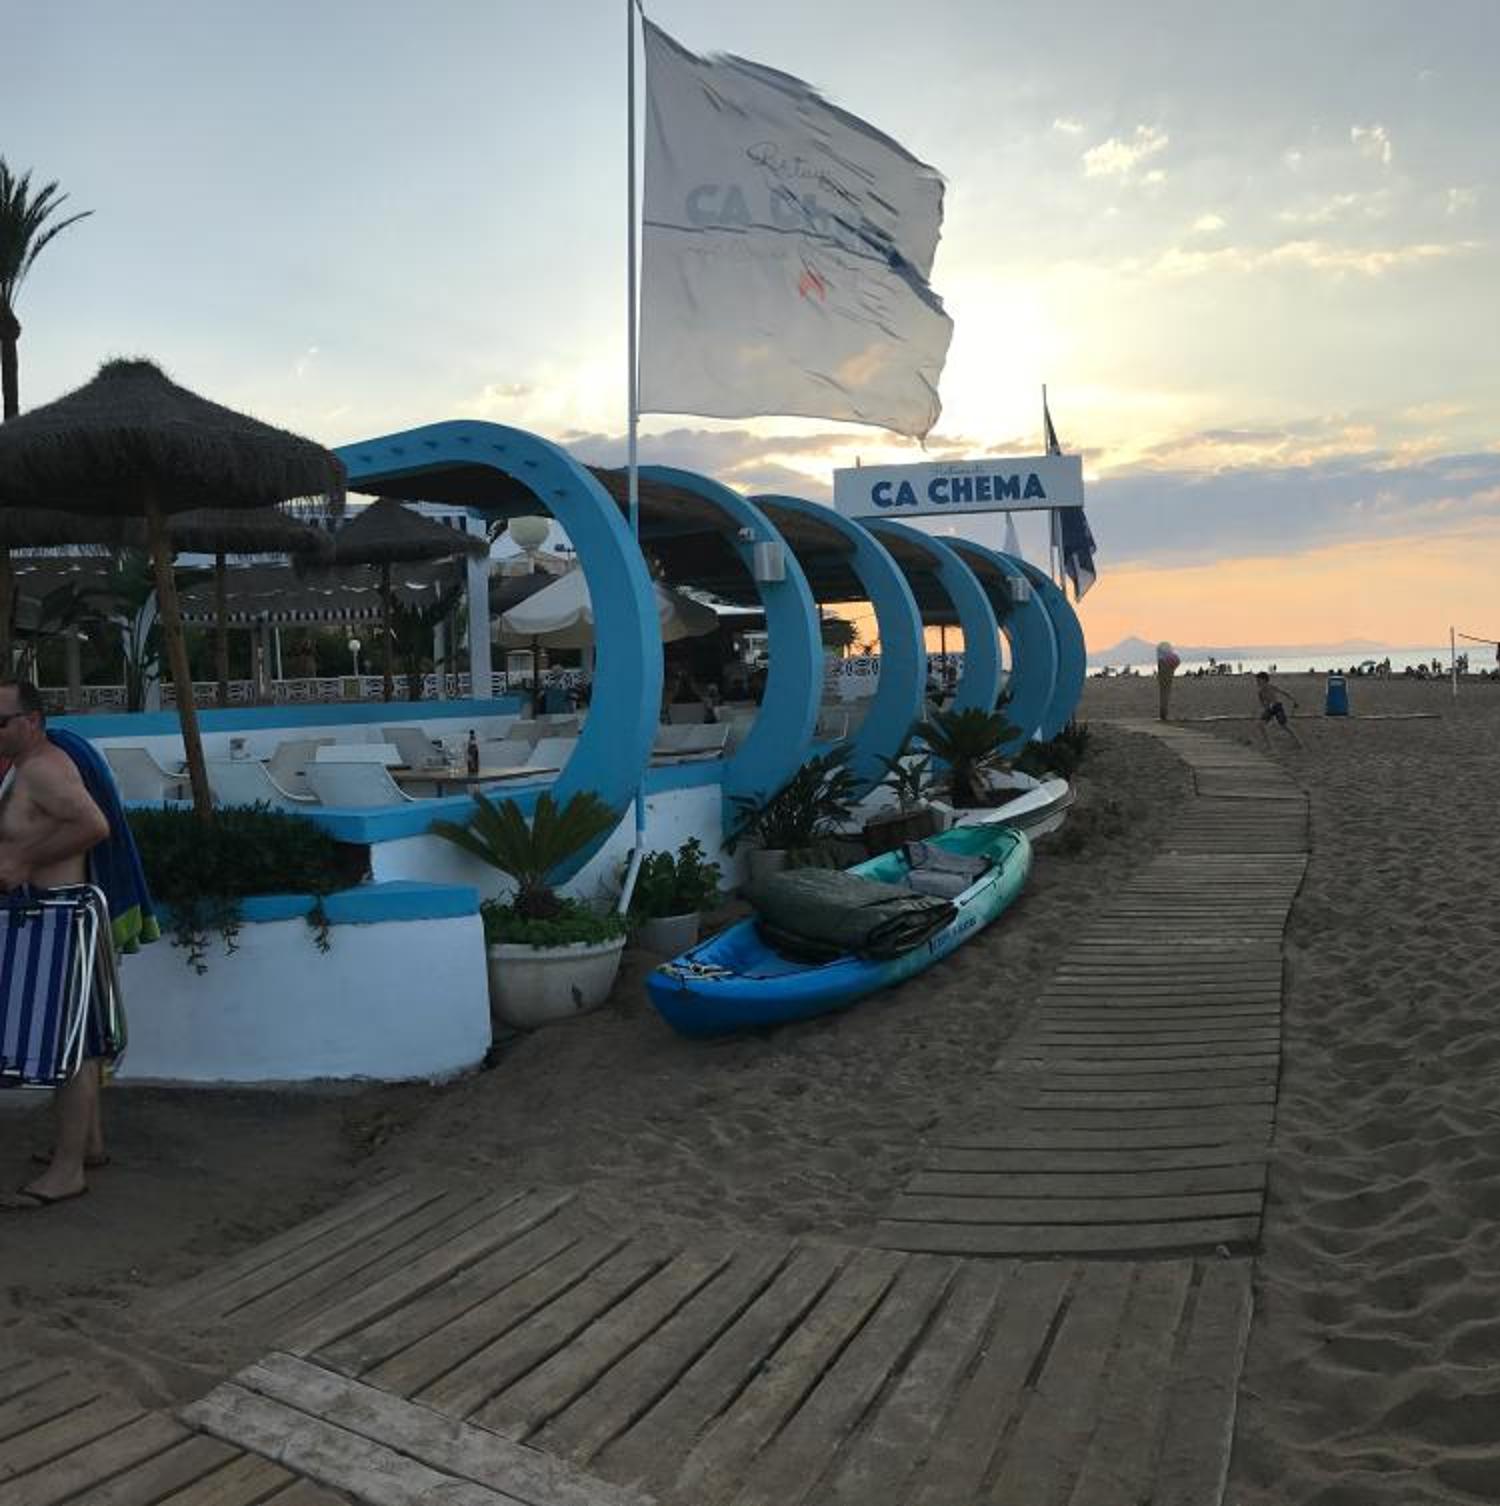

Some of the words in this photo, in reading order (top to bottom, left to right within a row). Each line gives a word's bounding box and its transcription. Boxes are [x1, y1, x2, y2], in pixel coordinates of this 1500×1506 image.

[685, 184, 752, 225] CA
[871, 480, 919, 508] CA
[928, 473, 1047, 504] CHEMA
